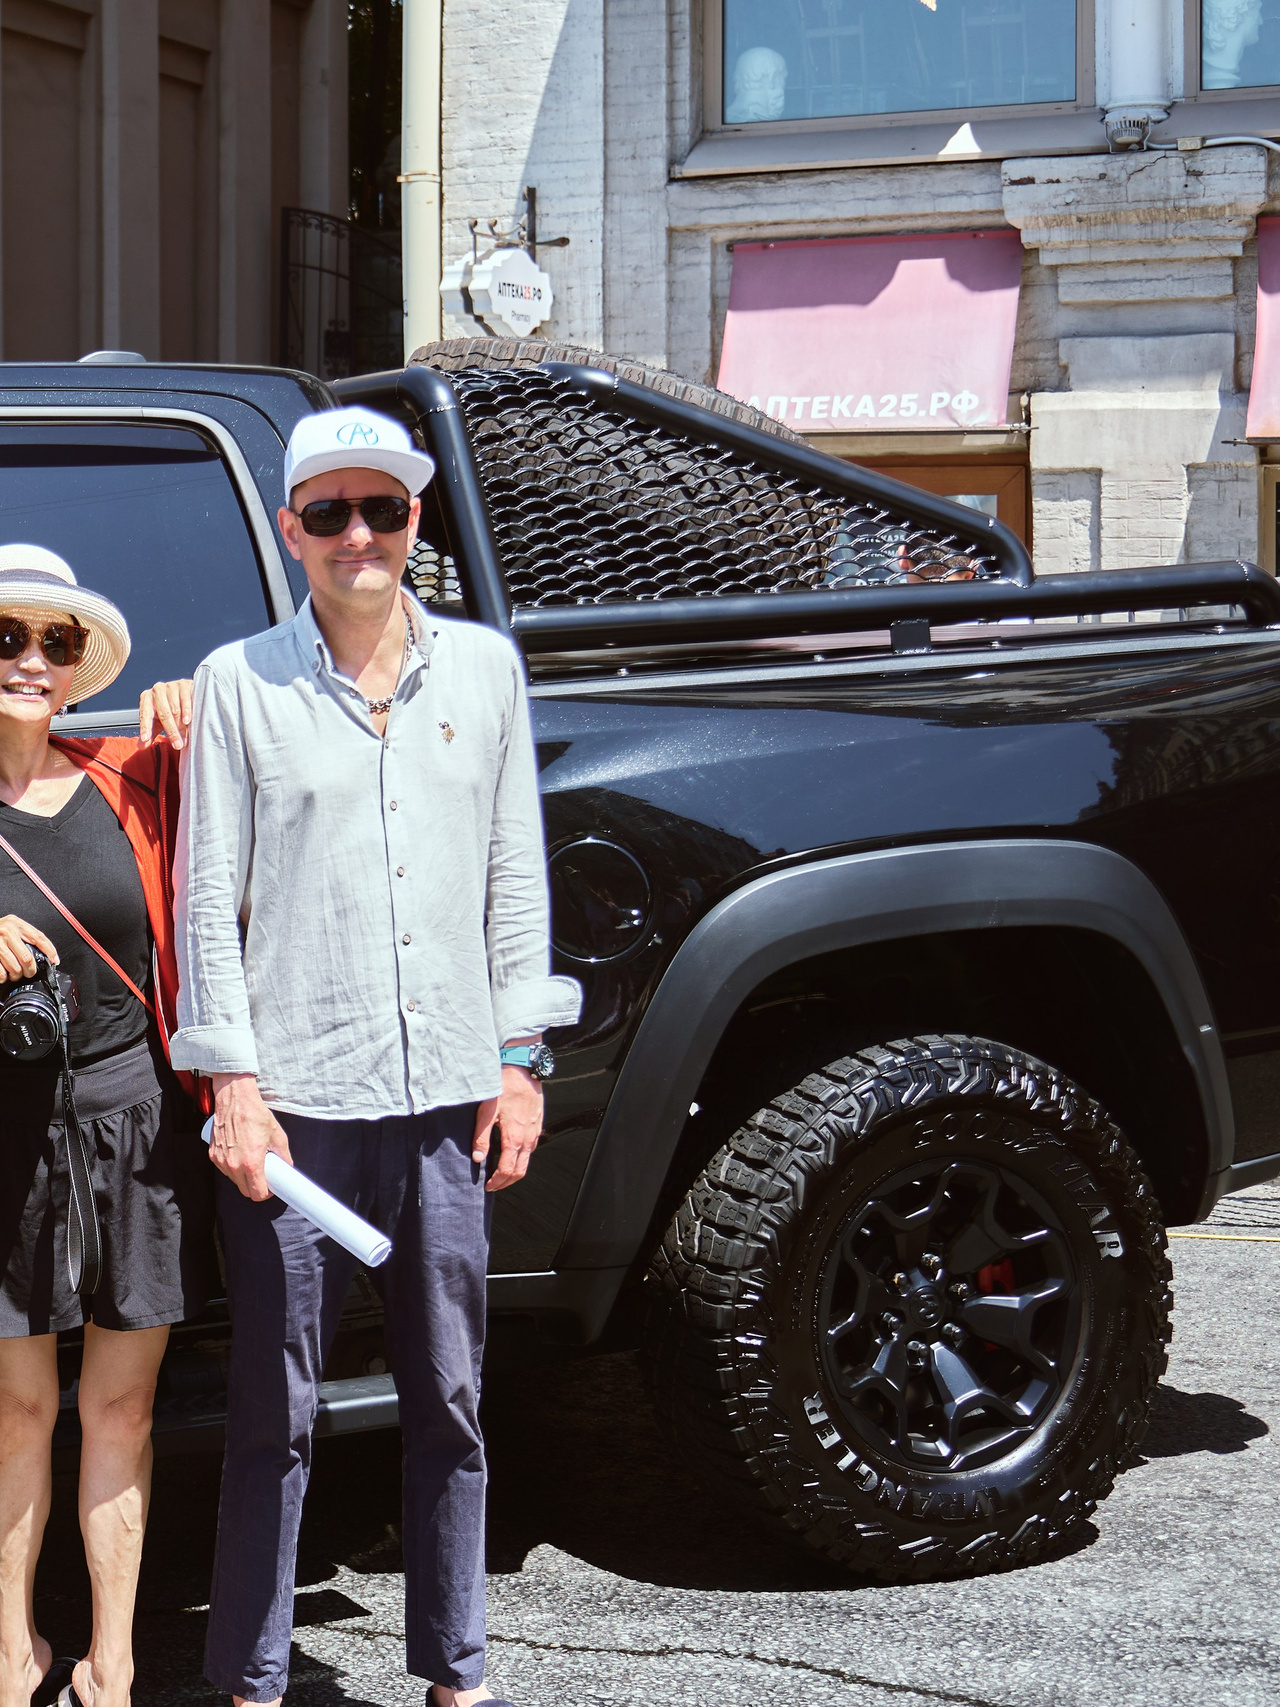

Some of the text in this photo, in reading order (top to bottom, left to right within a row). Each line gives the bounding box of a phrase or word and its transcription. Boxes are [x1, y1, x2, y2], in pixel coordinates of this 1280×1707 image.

[498, 282, 542, 301] АПТЕКА25.РФ
[511, 310, 531, 325] Pharmacy
[60, 1003, 70, 1022] Nikon
[20, 1025, 33, 1046] Nikon
[803, 1391, 1008, 1521] WRANGLER
